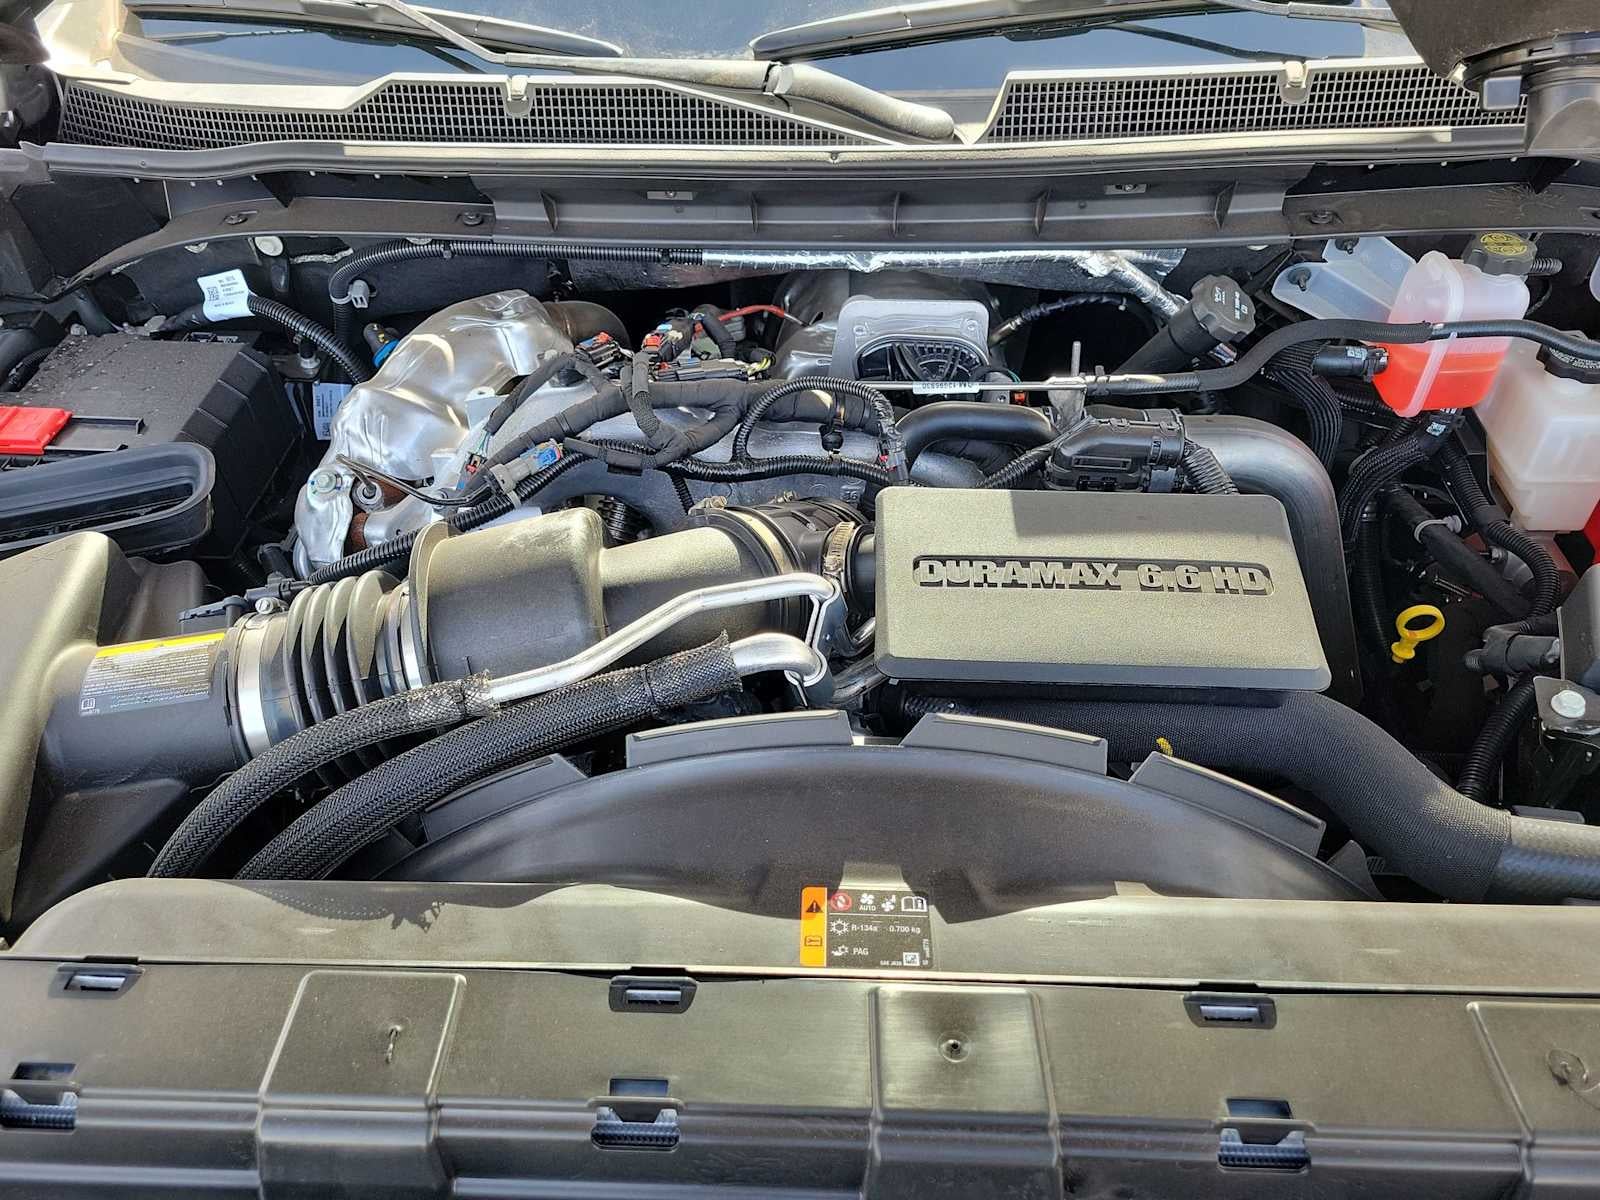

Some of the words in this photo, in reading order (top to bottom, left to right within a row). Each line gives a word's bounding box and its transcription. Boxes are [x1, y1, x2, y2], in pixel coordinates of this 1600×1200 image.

[919, 559, 1122, 590] DURAMAX
[1137, 563, 1202, 592] 6.6
[1210, 566, 1267, 595] HD
[889, 925, 910, 933] 0.700
[911, 925, 921, 934] kg
[853, 948, 869, 956] PAG
